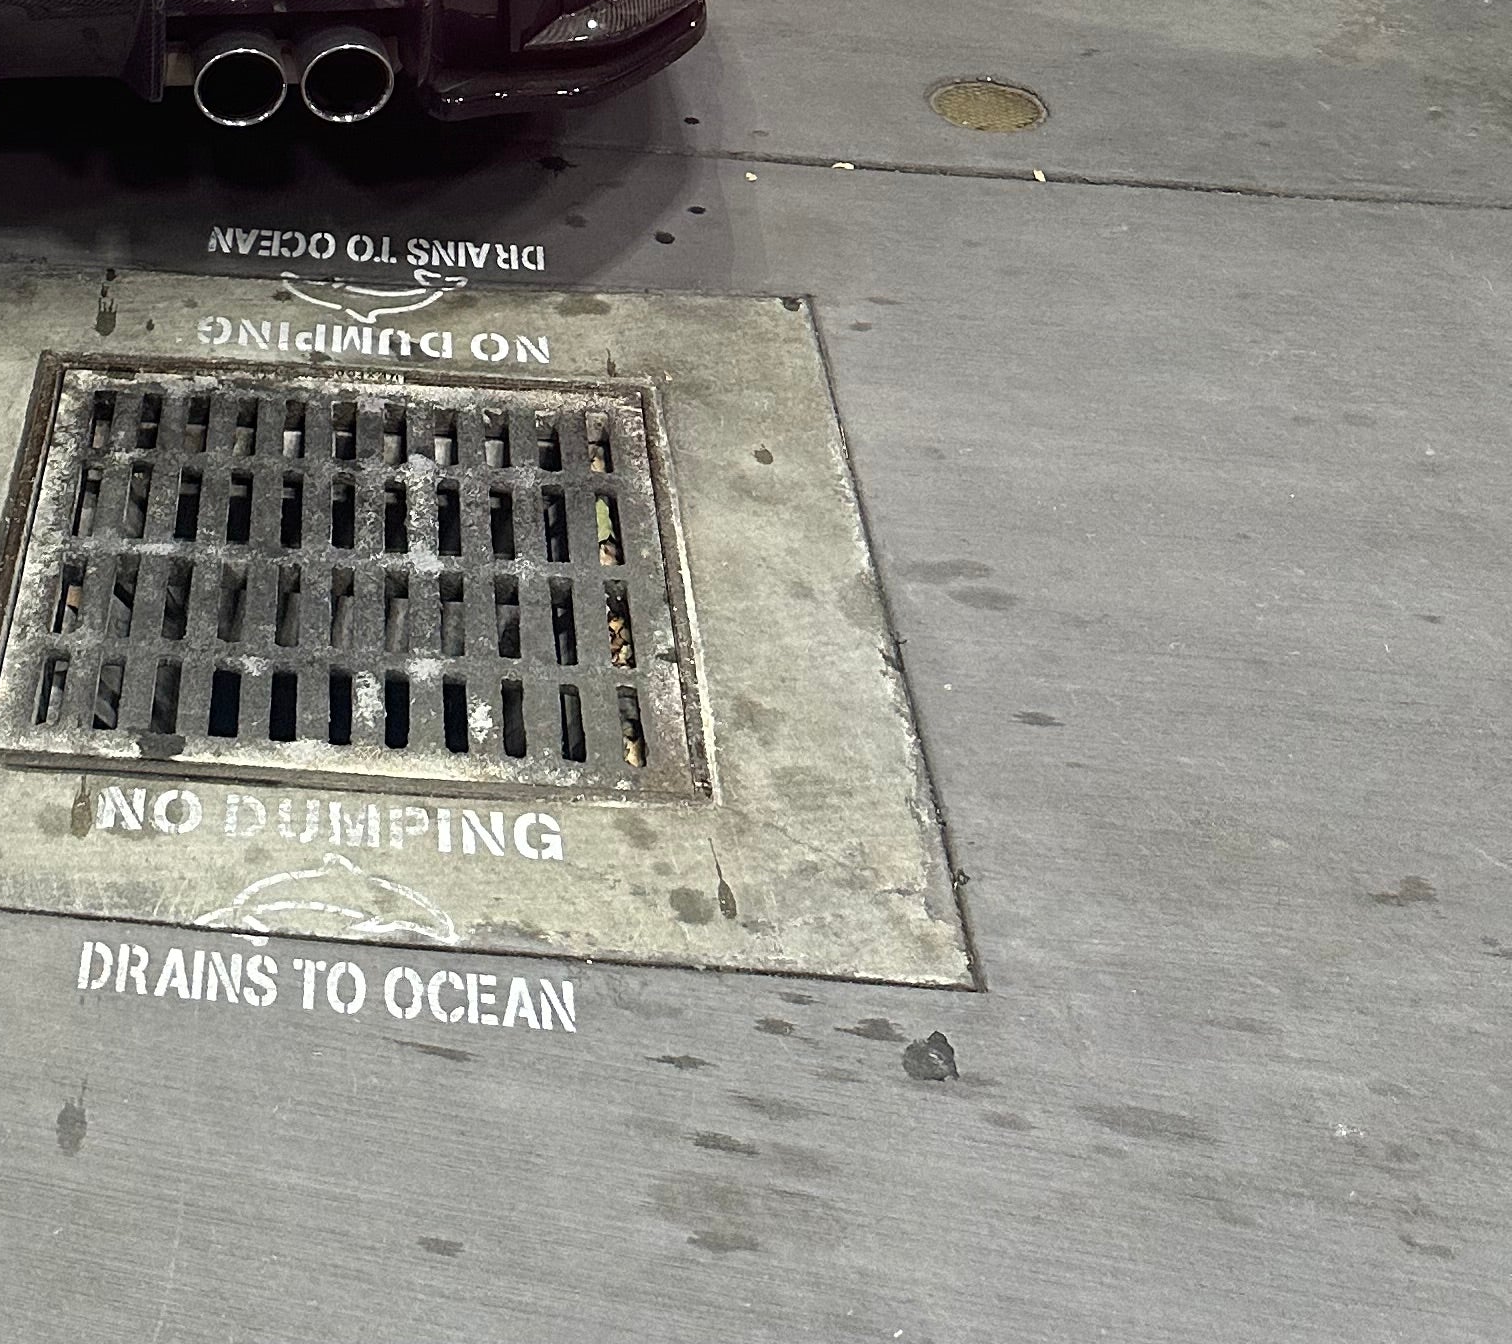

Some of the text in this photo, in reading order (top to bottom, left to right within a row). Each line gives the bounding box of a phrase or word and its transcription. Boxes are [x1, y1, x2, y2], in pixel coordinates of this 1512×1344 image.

[208, 226, 545, 271] DRAINS TO OCEAN
[197, 316, 550, 363] NO DUMPING
[96, 785, 564, 861] NO DUMPING
[78, 941, 577, 1034] DRAINS TO OCEAN
